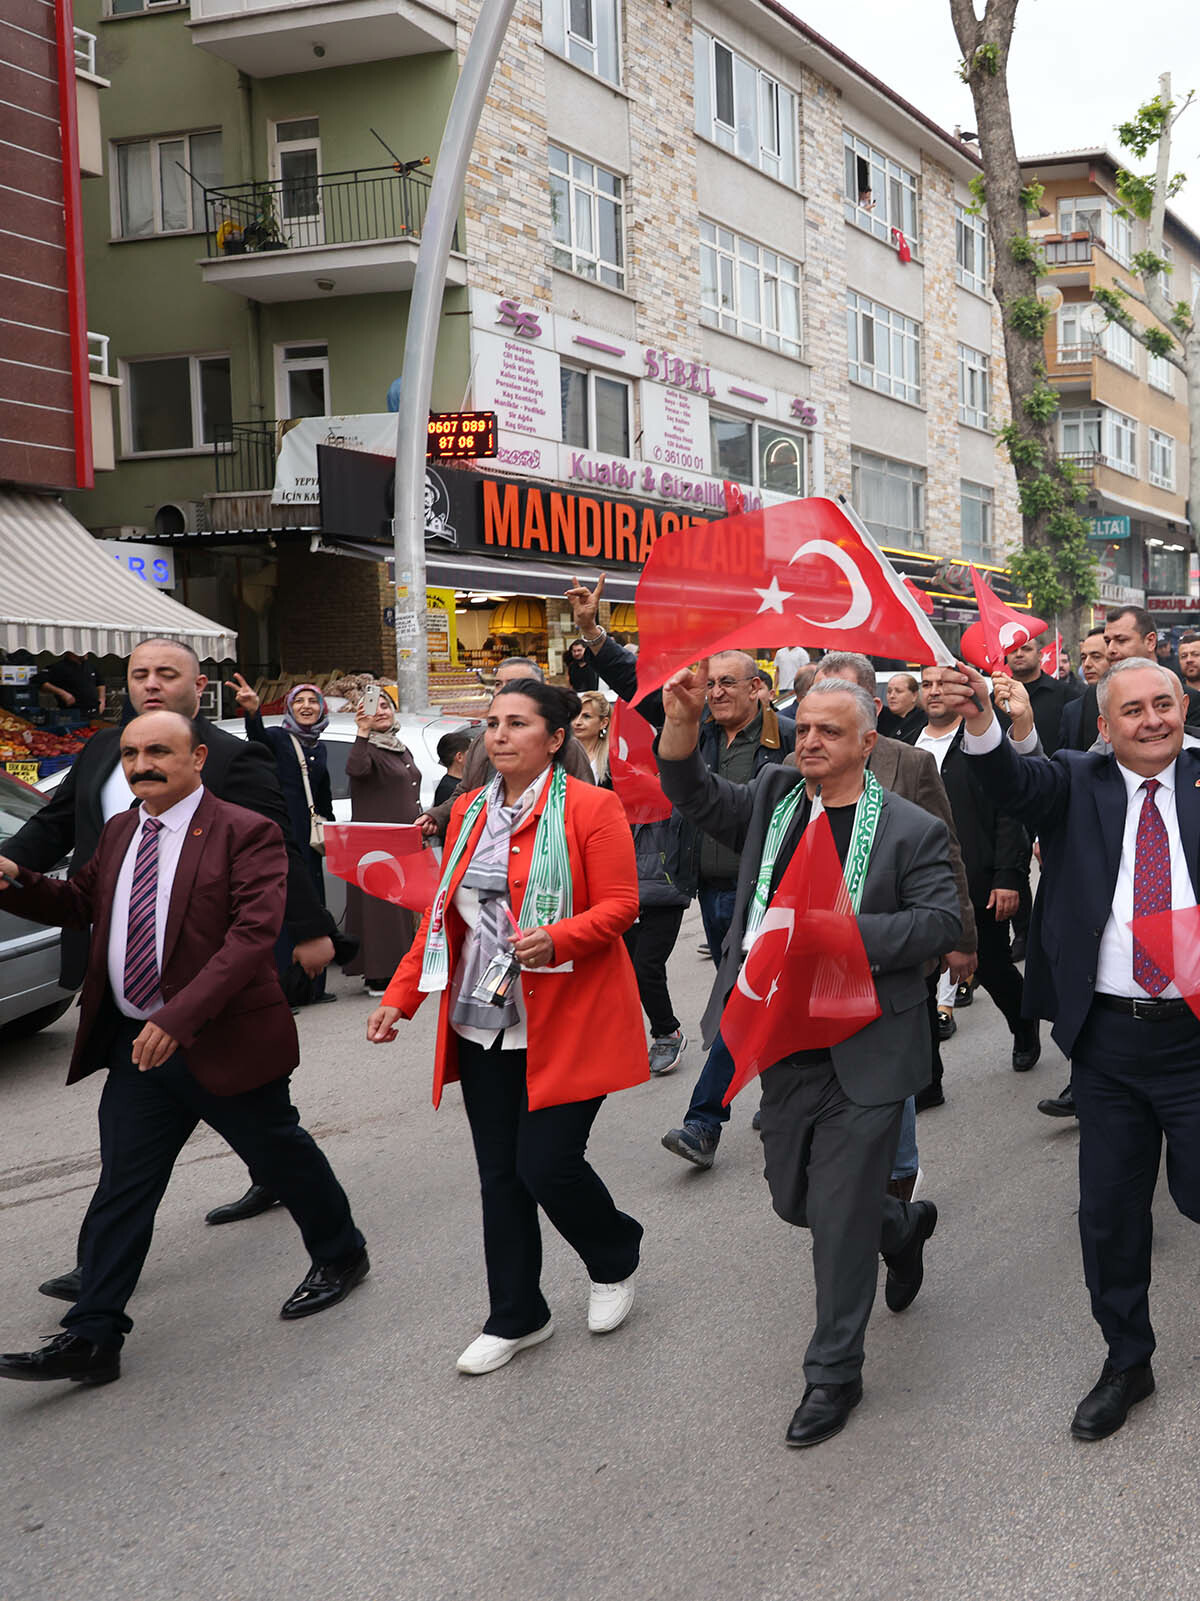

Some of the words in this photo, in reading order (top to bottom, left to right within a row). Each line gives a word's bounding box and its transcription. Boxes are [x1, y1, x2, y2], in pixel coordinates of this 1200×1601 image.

[645, 349, 717, 398] SİBEL
[462, 420, 486, 432] 089
[694, 456, 704, 470] 01
[295, 477, 320, 487] YEPY
[281, 489, 301, 502] İÇİN
[661, 472, 726, 508] Güzellik
